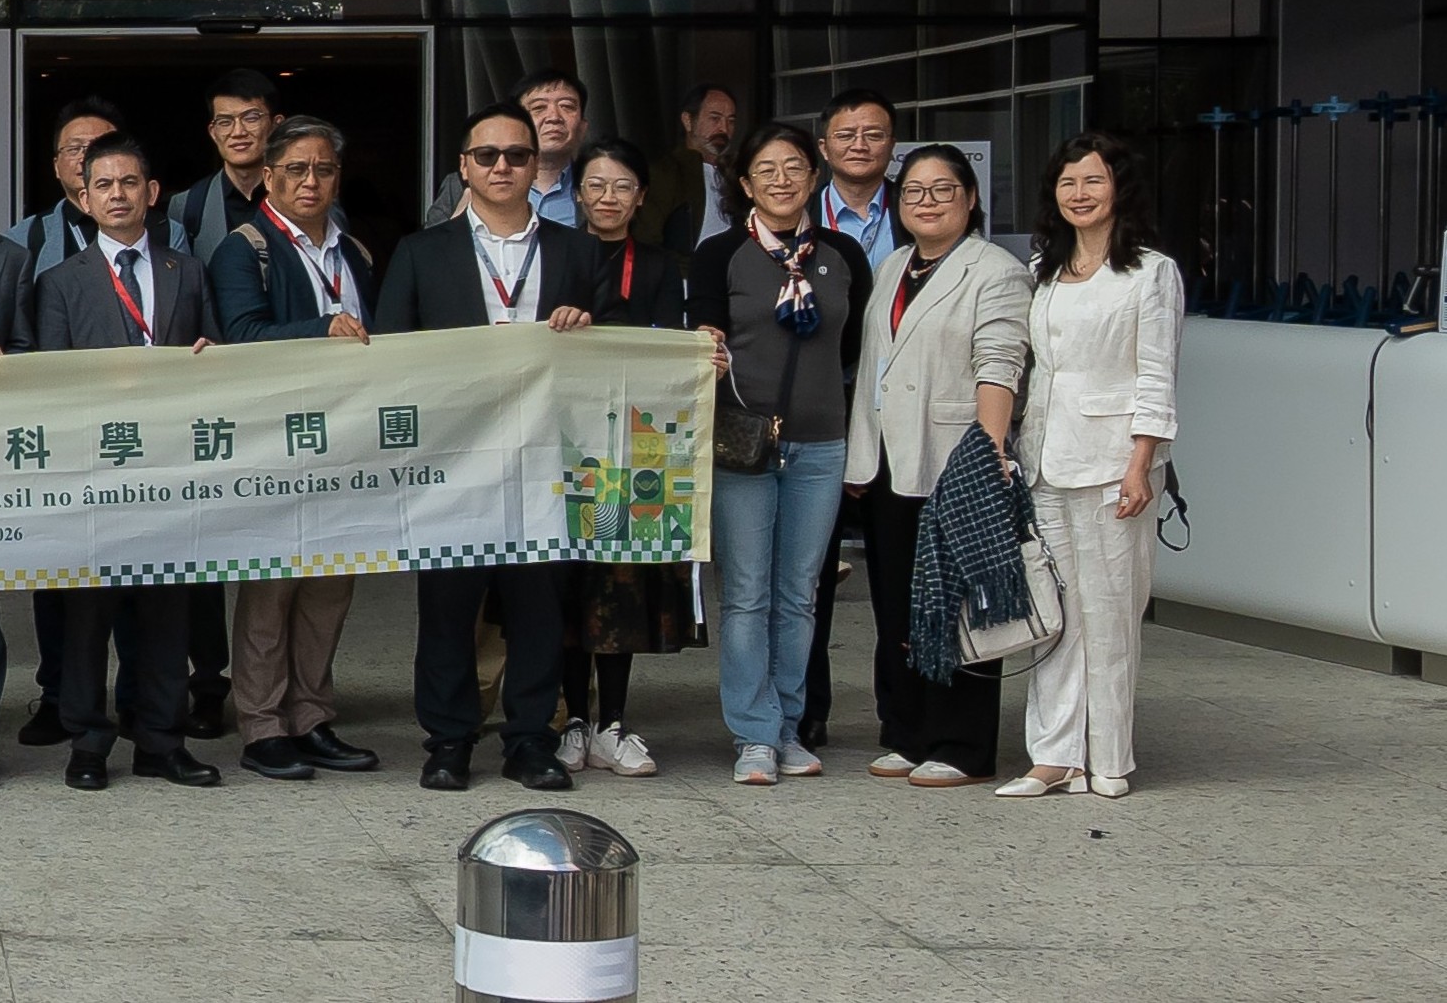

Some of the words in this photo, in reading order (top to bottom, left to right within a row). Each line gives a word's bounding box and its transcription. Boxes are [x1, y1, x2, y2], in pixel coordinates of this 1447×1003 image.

[42, 493, 71, 507] no
[83, 483, 171, 505] âmbito
[182, 481, 224, 500] das
[233, 473, 342, 498] Ciências
[350, 471, 381, 490] da
[388, 465, 446, 488] Vida
